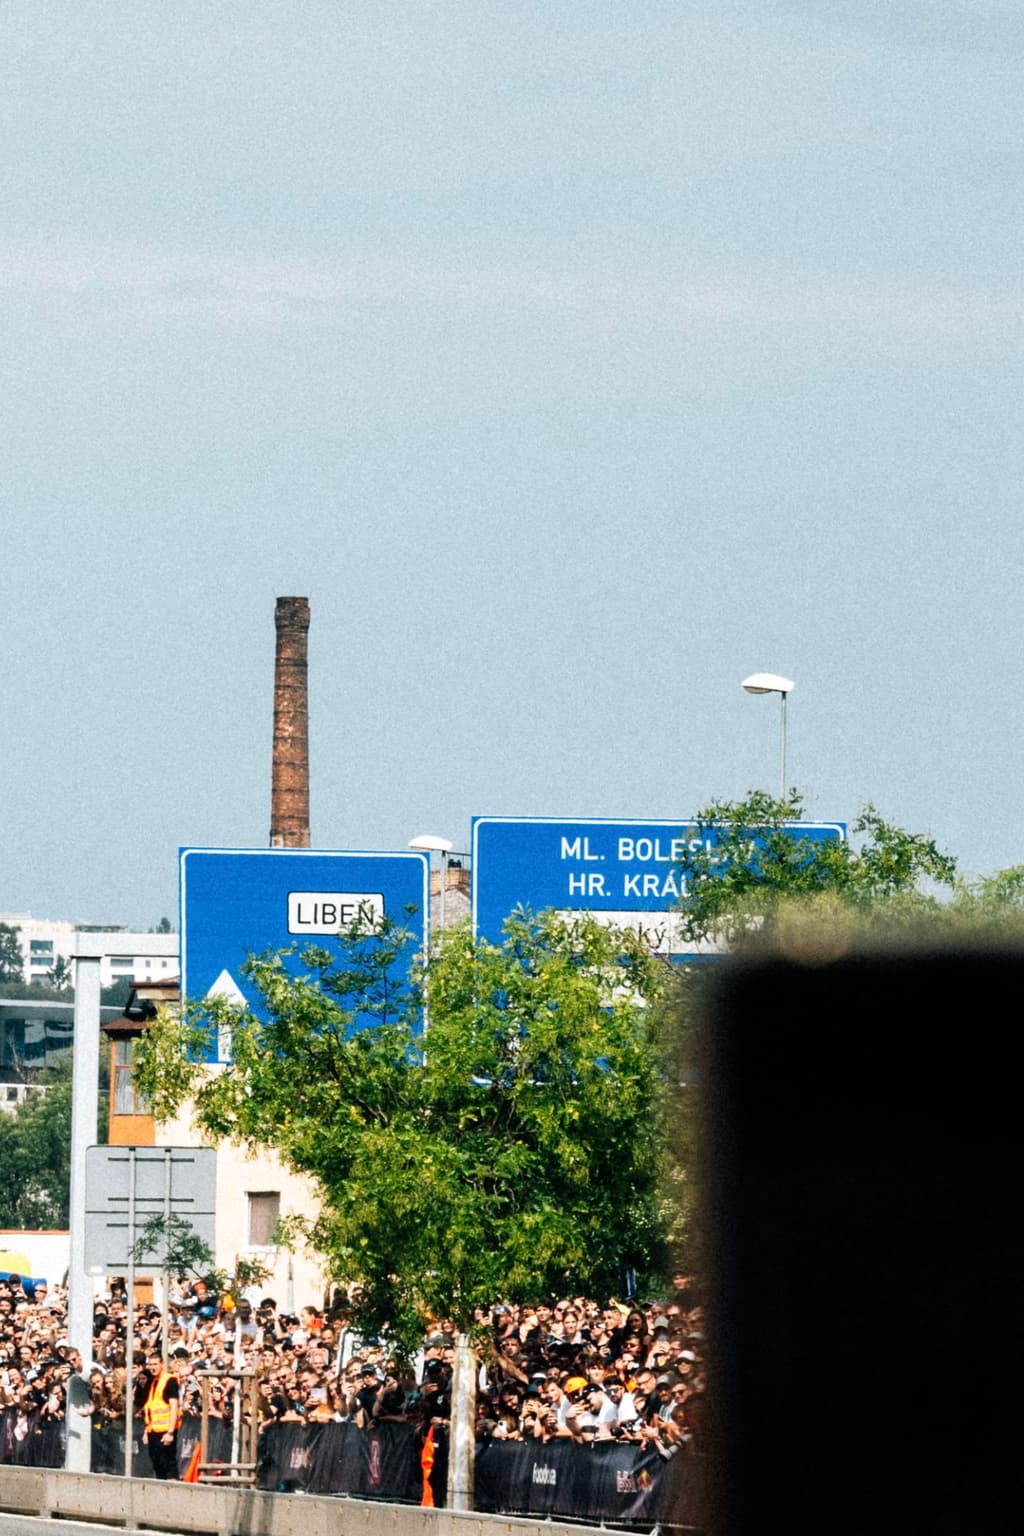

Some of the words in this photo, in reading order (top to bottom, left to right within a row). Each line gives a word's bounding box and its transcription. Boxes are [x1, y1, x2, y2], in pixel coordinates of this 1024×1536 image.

[560, 837, 605, 860] ML.
[568, 873, 611, 896] HR.
[297, 898, 374, 925] LIBEŇ
